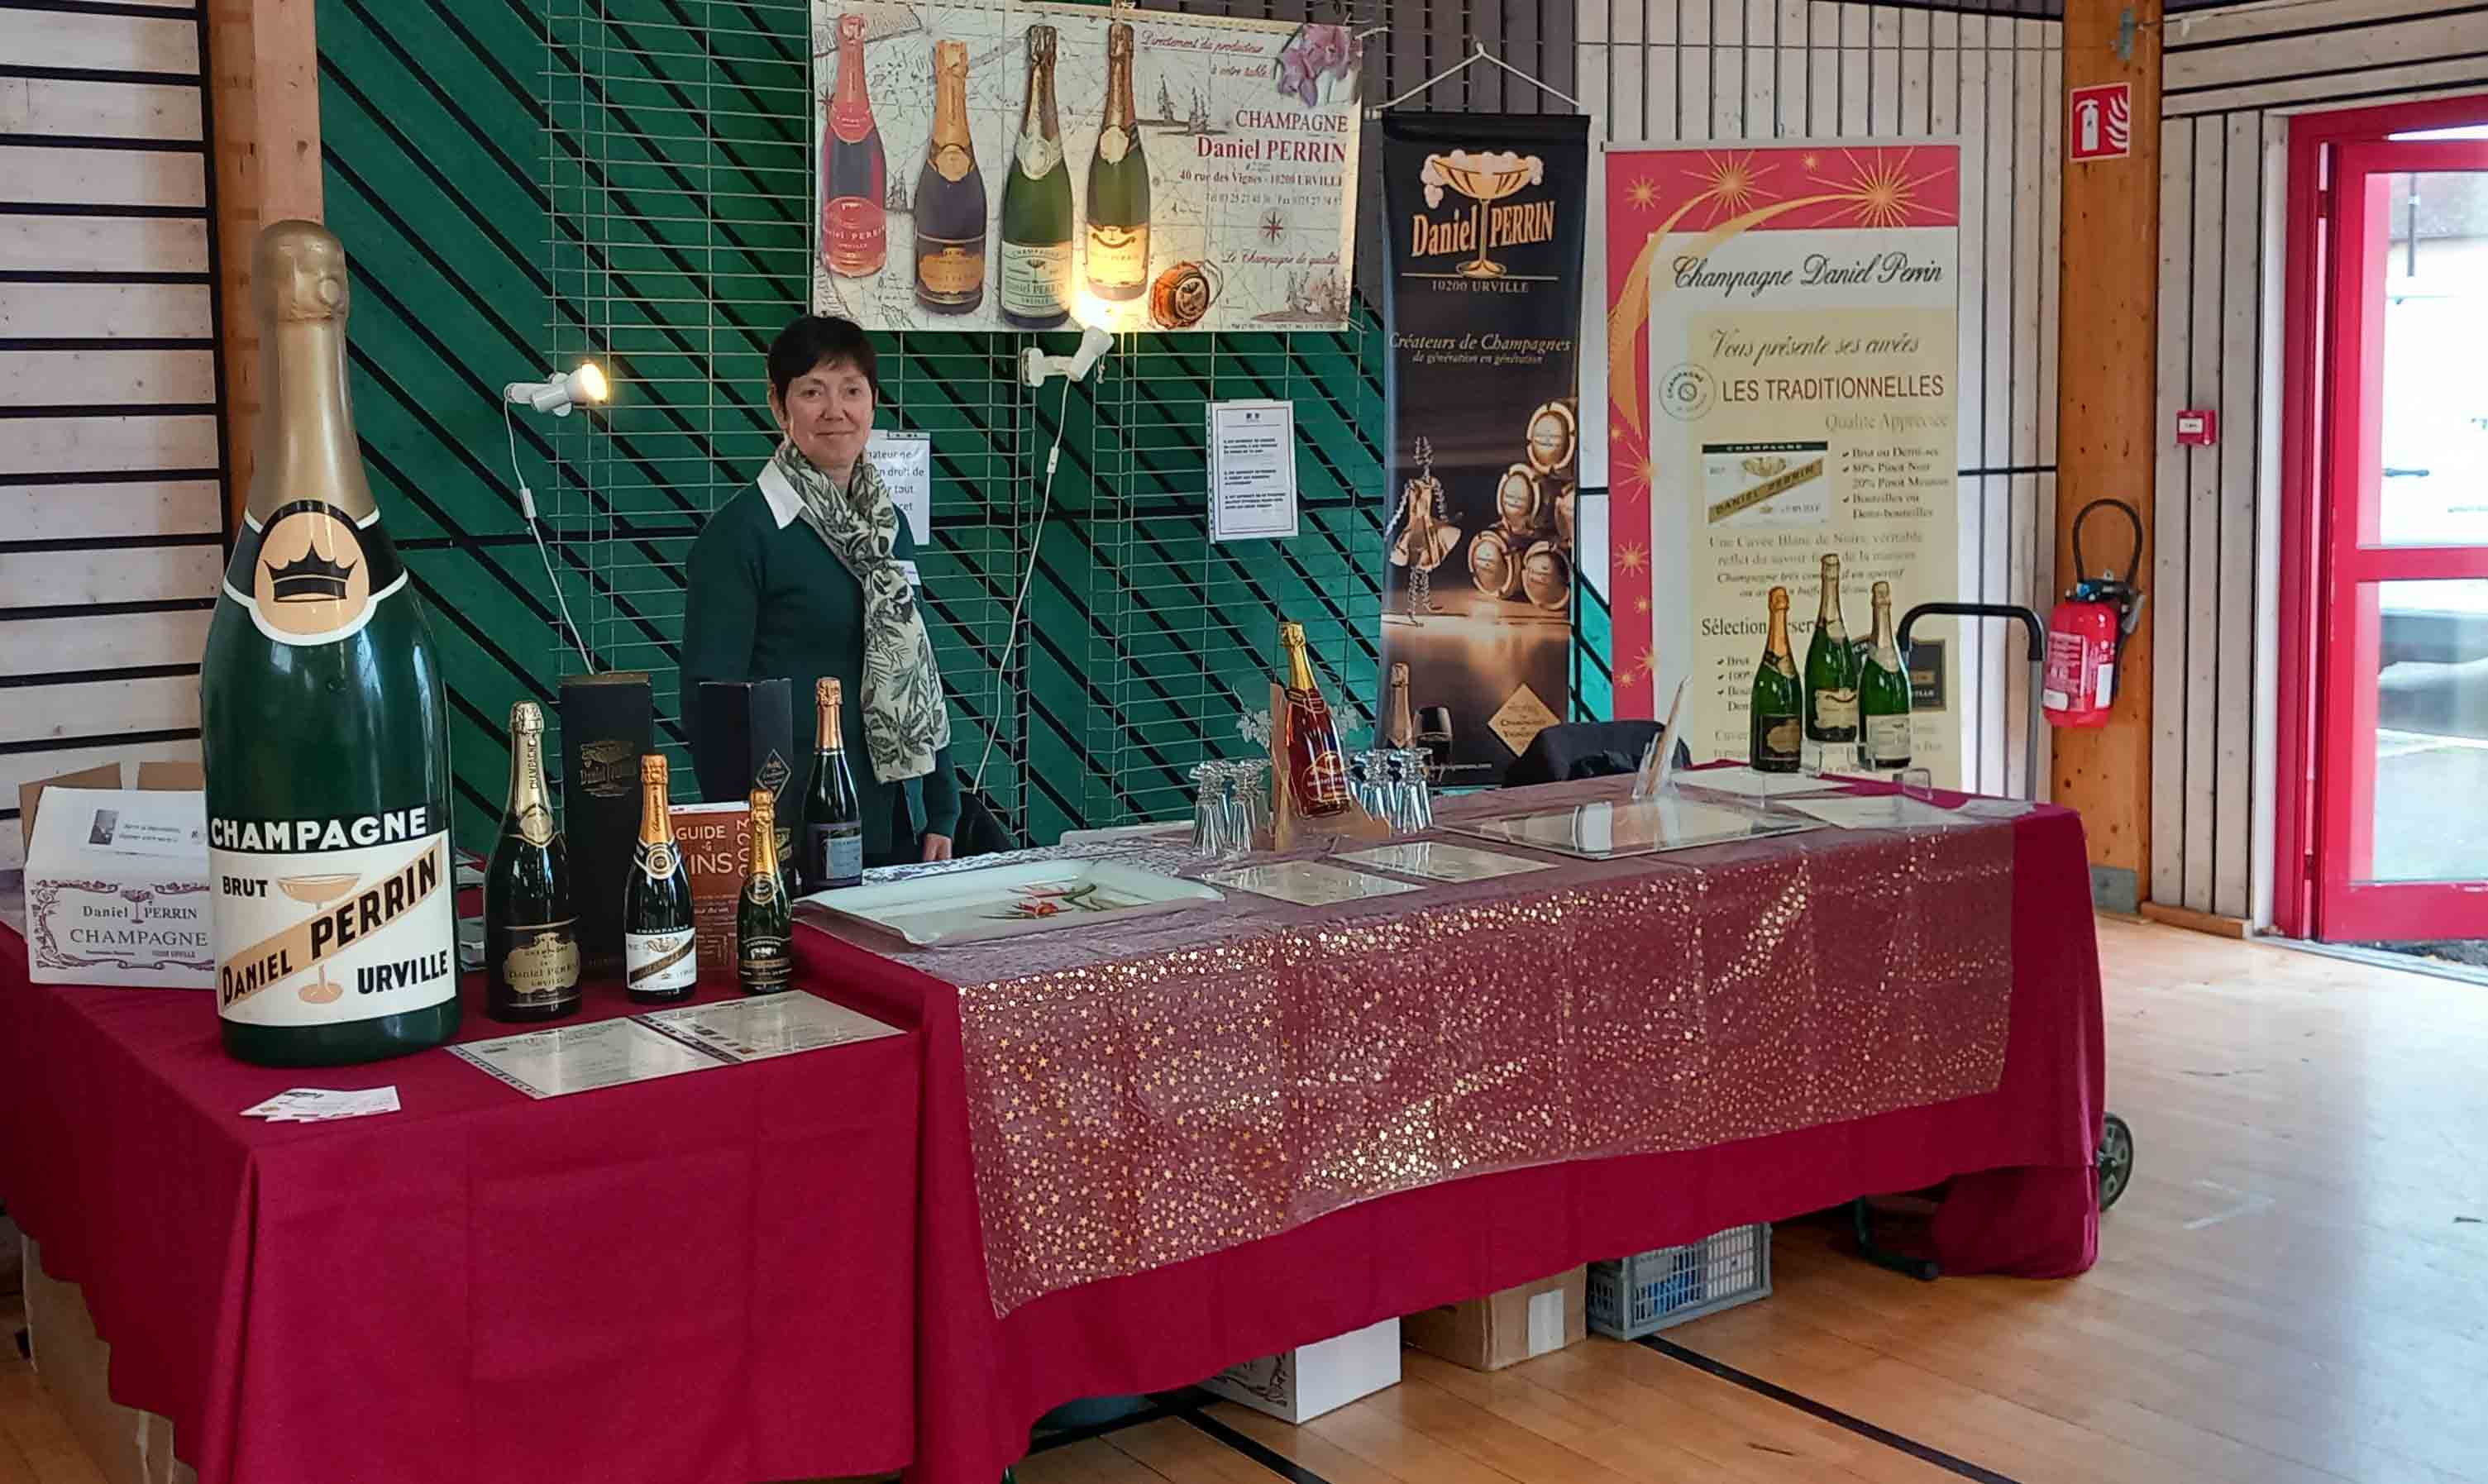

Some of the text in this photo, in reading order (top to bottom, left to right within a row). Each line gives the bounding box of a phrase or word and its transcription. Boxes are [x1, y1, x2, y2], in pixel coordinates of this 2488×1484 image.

[1235, 109, 1349, 132] CHAMPAGNE
[1197, 136, 1347, 163] Daniel PERRIN
[1194, 172, 1211, 181] rue
[1213, 172, 1229, 183] des
[1411, 201, 1555, 257] Daniel PERRIN
[1673, 251, 1942, 298] Champagne Daniel Perrin
[1472, 280, 1529, 293] URVILLE
[1389, 332, 1572, 354] Créateurs de Champagnes
[1712, 328, 1754, 358] Vous
[1753, 334, 1831, 366] présente
[1835, 340, 1860, 355] ses
[1722, 379, 1760, 403] LES
[1767, 375, 1944, 401] TRADITIONNELLES
[912, 467, 925, 477] de
[894, 485, 914, 494] tout
[1702, 617, 1767, 636] Sélection
[211, 807, 426, 852] CHAMPAGNE
[675, 825, 727, 841] GUIDE
[690, 852, 733, 876] INS
[222, 875, 269, 898] BRUT
[83, 905, 198, 920] Daniel PERRIN
[70, 928, 208, 947] CHAMPAGNE
[222, 850, 437, 1006] DANIEL PERRIN
[357, 949, 448, 995] URVILLE
